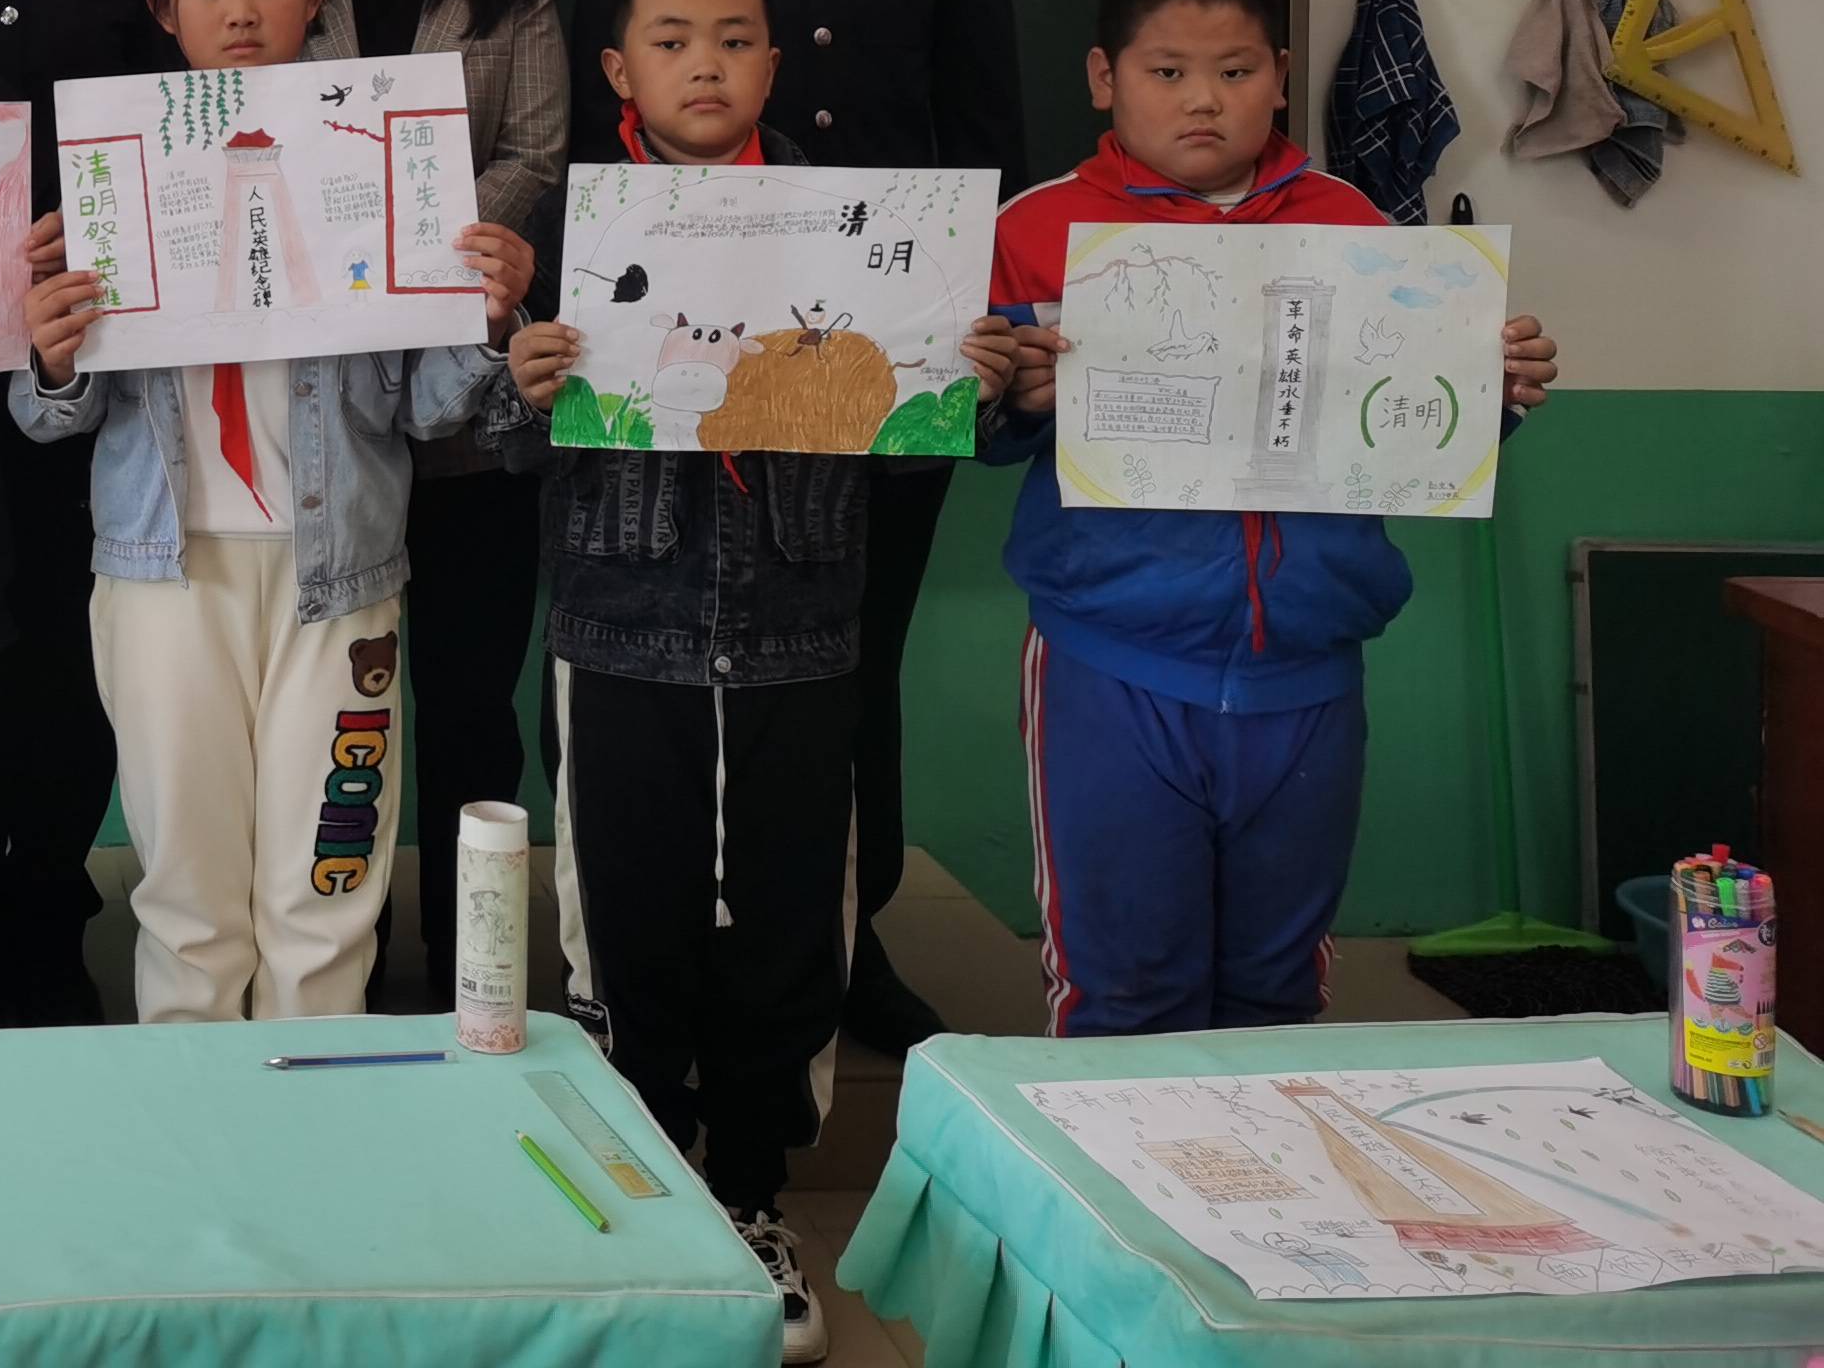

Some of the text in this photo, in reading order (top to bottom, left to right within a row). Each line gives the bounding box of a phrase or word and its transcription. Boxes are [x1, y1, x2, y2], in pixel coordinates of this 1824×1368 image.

[247, 185, 274, 308] 人民英雄纪念碑
[398, 119, 443, 247] 缅怀先烈
[1272, 299, 1306, 448] 革命英雄永垂不朽
[625, 479, 641, 525] PARIS
[311, 708, 391, 896] ICONIC
